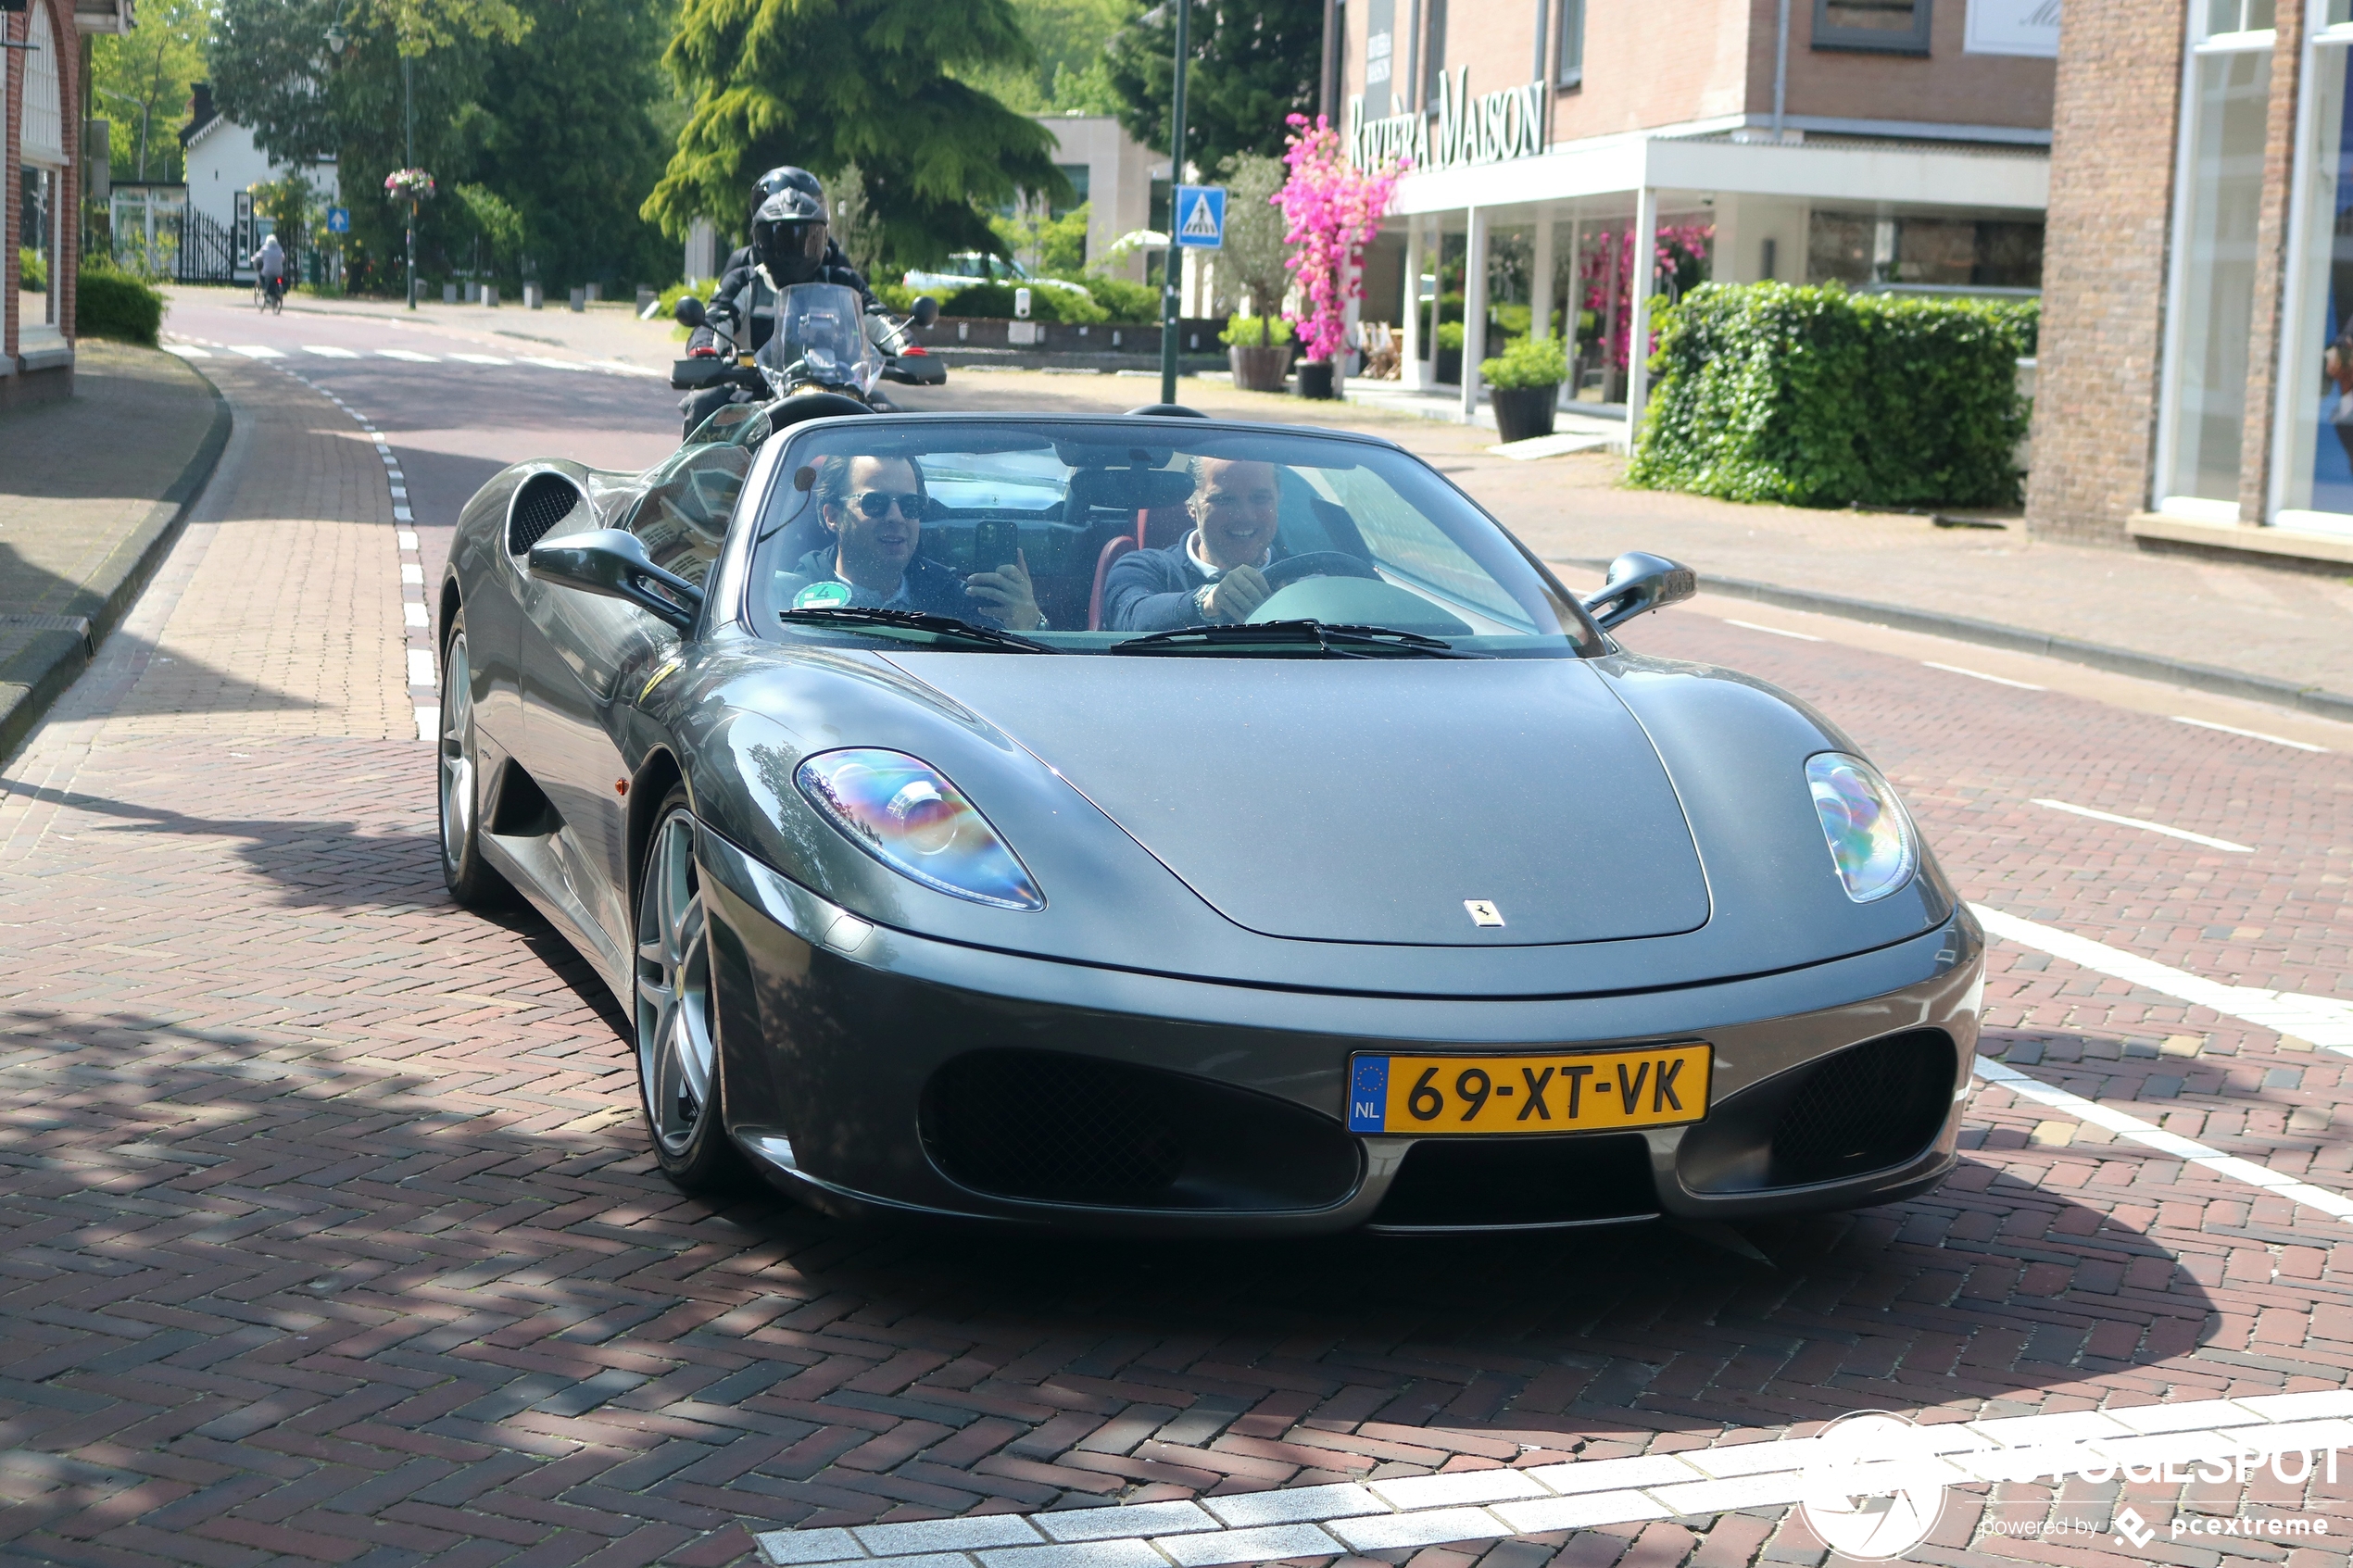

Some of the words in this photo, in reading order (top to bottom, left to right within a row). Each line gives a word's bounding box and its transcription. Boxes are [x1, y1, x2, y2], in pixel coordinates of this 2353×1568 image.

[1437, 64, 1546, 171] MAISON
[815, 585, 830, 598] 4
[1354, 1100, 1380, 1120] NL
[1407, 1059, 1686, 1122] 69-XT-VK
